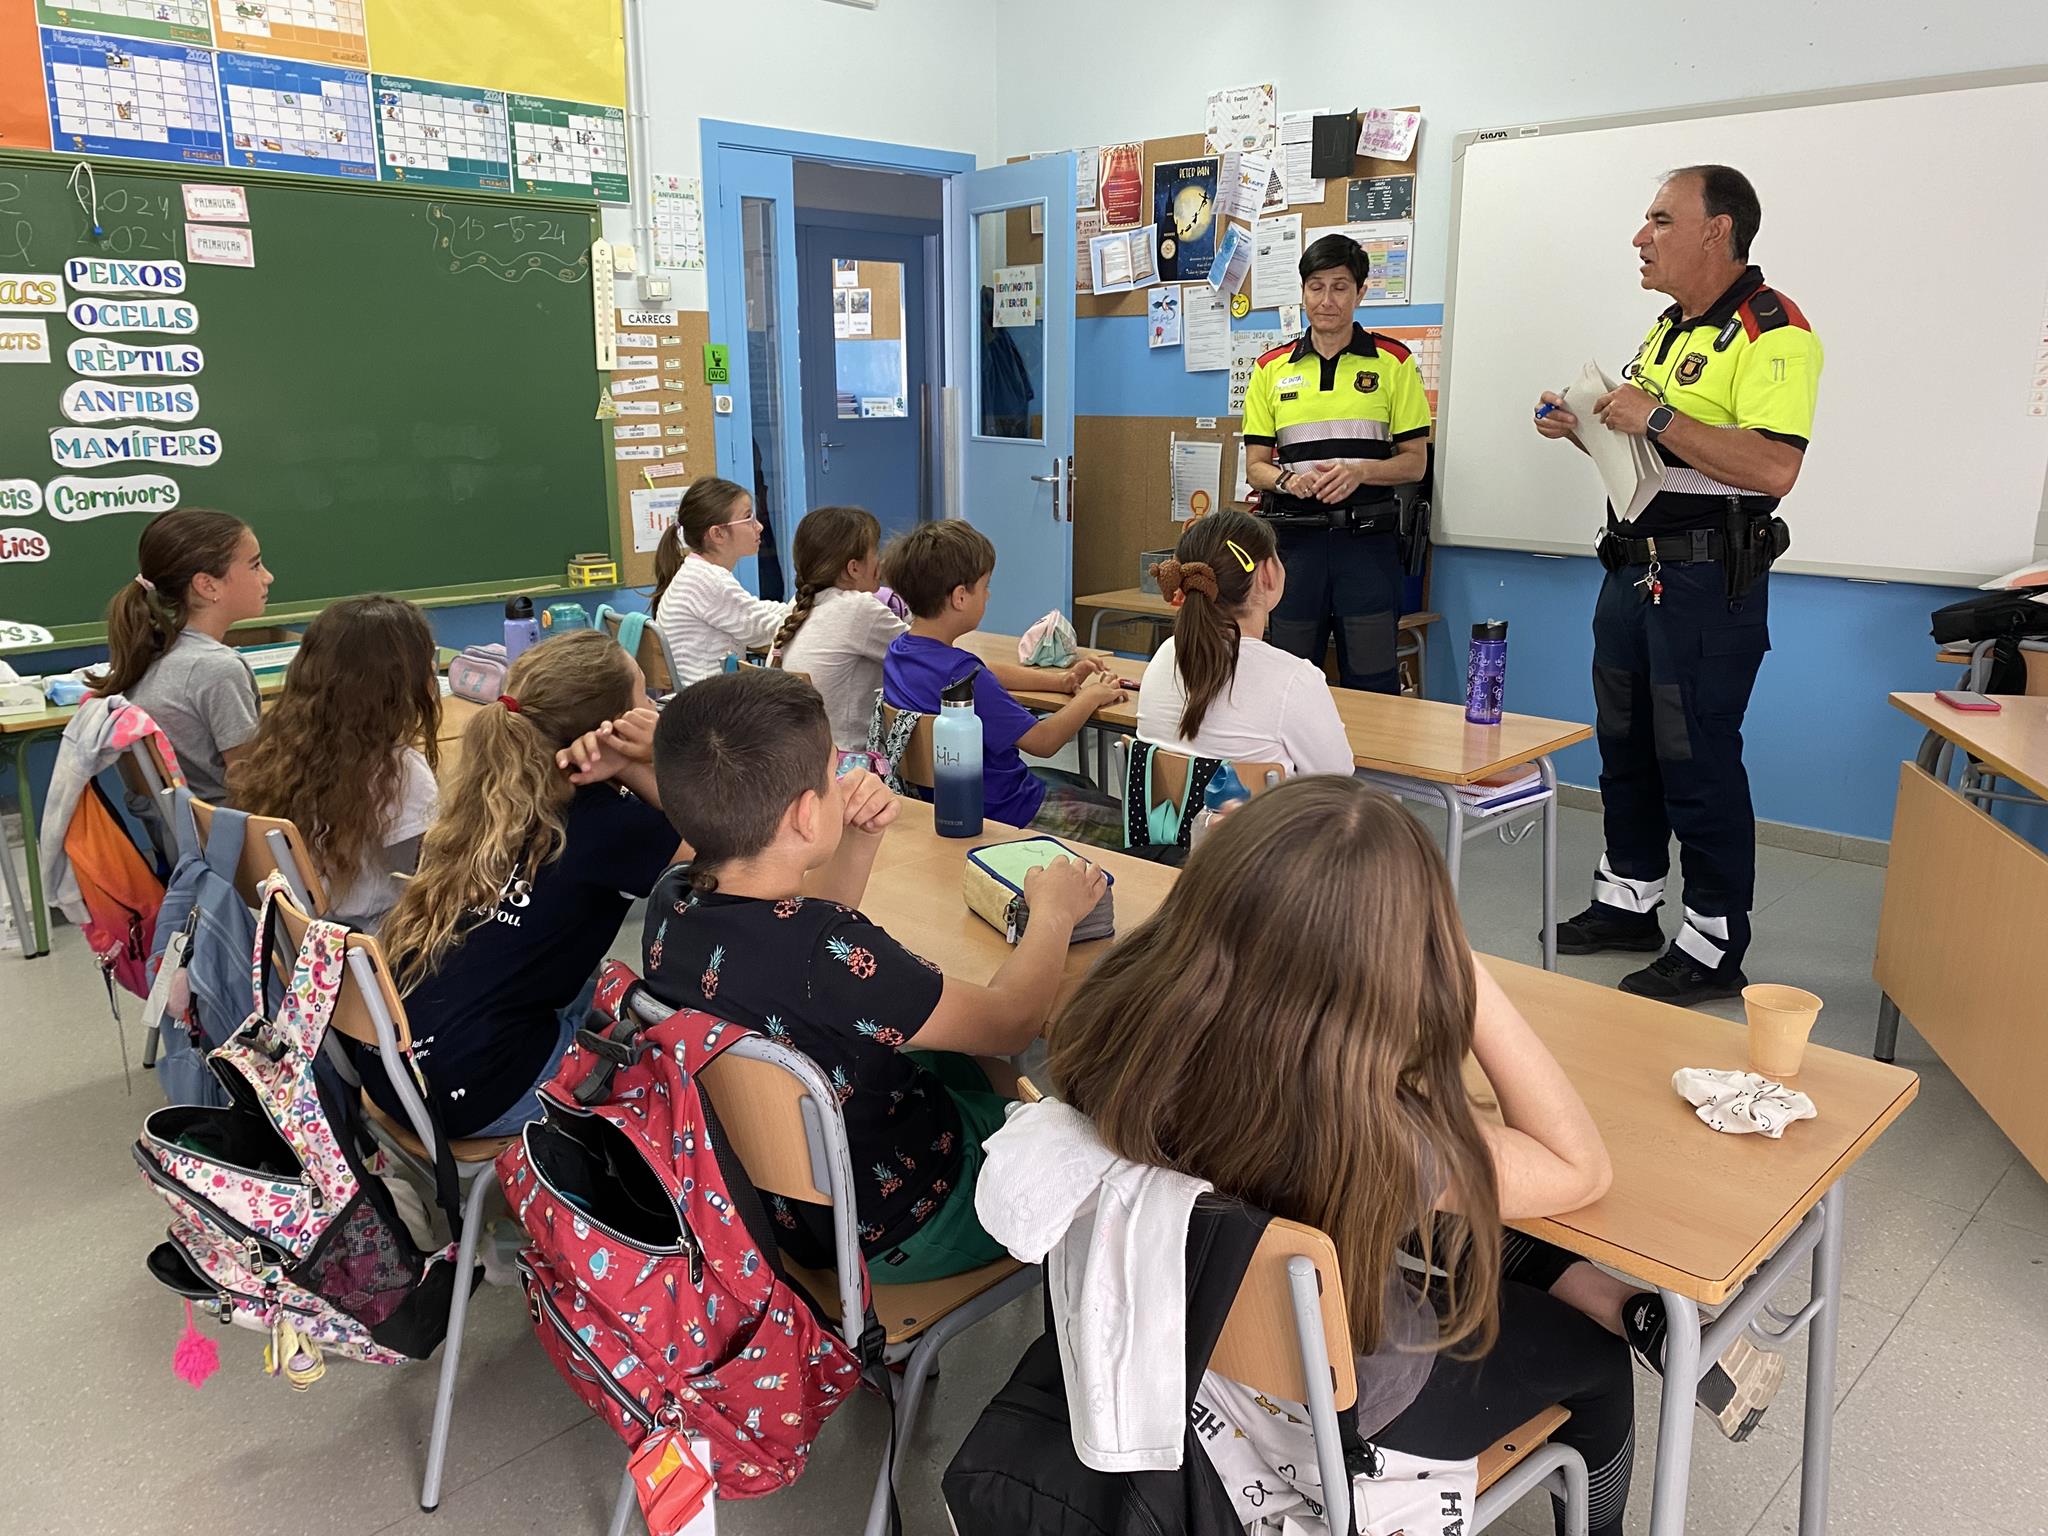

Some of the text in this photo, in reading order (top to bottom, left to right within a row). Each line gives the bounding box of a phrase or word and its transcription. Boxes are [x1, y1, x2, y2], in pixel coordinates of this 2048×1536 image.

[186, 49, 211, 63] 2023
[344, 71, 367, 82] 2023
[483, 90, 504, 103] 2024
[604, 107, 622, 118] 2024
[1179, 165, 1210, 179] PETER PAN
[657, 191, 695, 200] ANIVERSARIS
[194, 197, 236, 209] PRIMAVERA
[197, 238, 242, 252] PRIMAVERA
[70, 261, 182, 288] PEIXOS
[995, 281, 1033, 293] BENVINGUTS
[1006, 297, 1028, 308] TERCER
[74, 304, 193, 329] OCELLS
[628, 314, 672, 324] CARRECS
[74, 343, 200, 372] RÈPTILS
[1237, 357, 1256, 366] 6 7
[710, 370, 726, 379] WC
[1234, 372, 1246, 380] 13
[1233, 386, 1245, 394] 20
[73, 390, 194, 413] ANFIBIS
[1233, 400, 1244, 408] 27
[55, 430, 217, 459] MAMÍFERS
[54, 484, 177, 515] Carnívors
